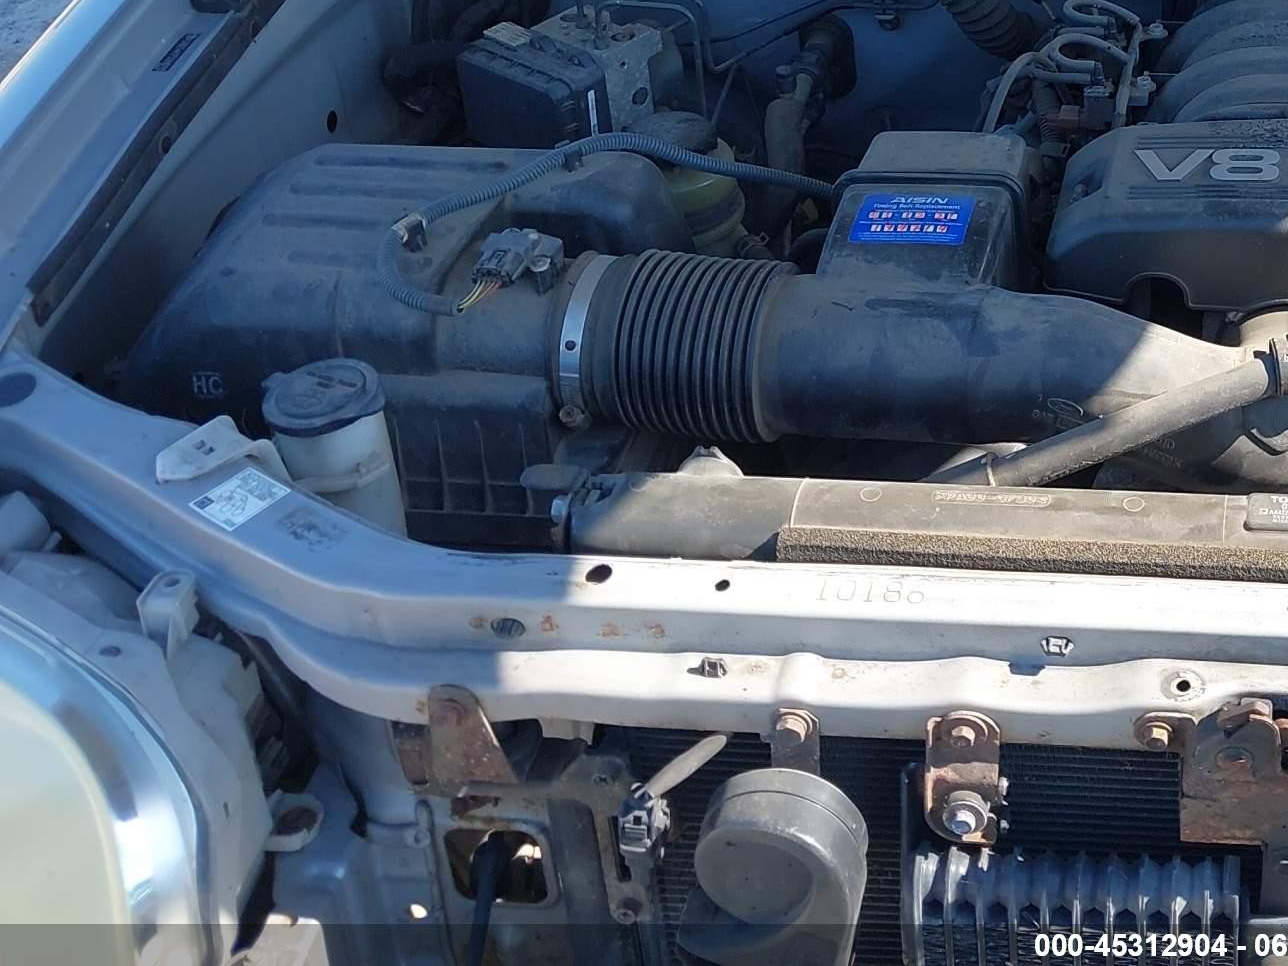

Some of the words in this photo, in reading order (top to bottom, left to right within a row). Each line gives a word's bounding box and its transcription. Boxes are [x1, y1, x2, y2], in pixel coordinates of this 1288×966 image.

[1131, 148, 1280, 182] V8
[890, 196, 949, 204] AISIN
[192, 374, 224, 395] HC
